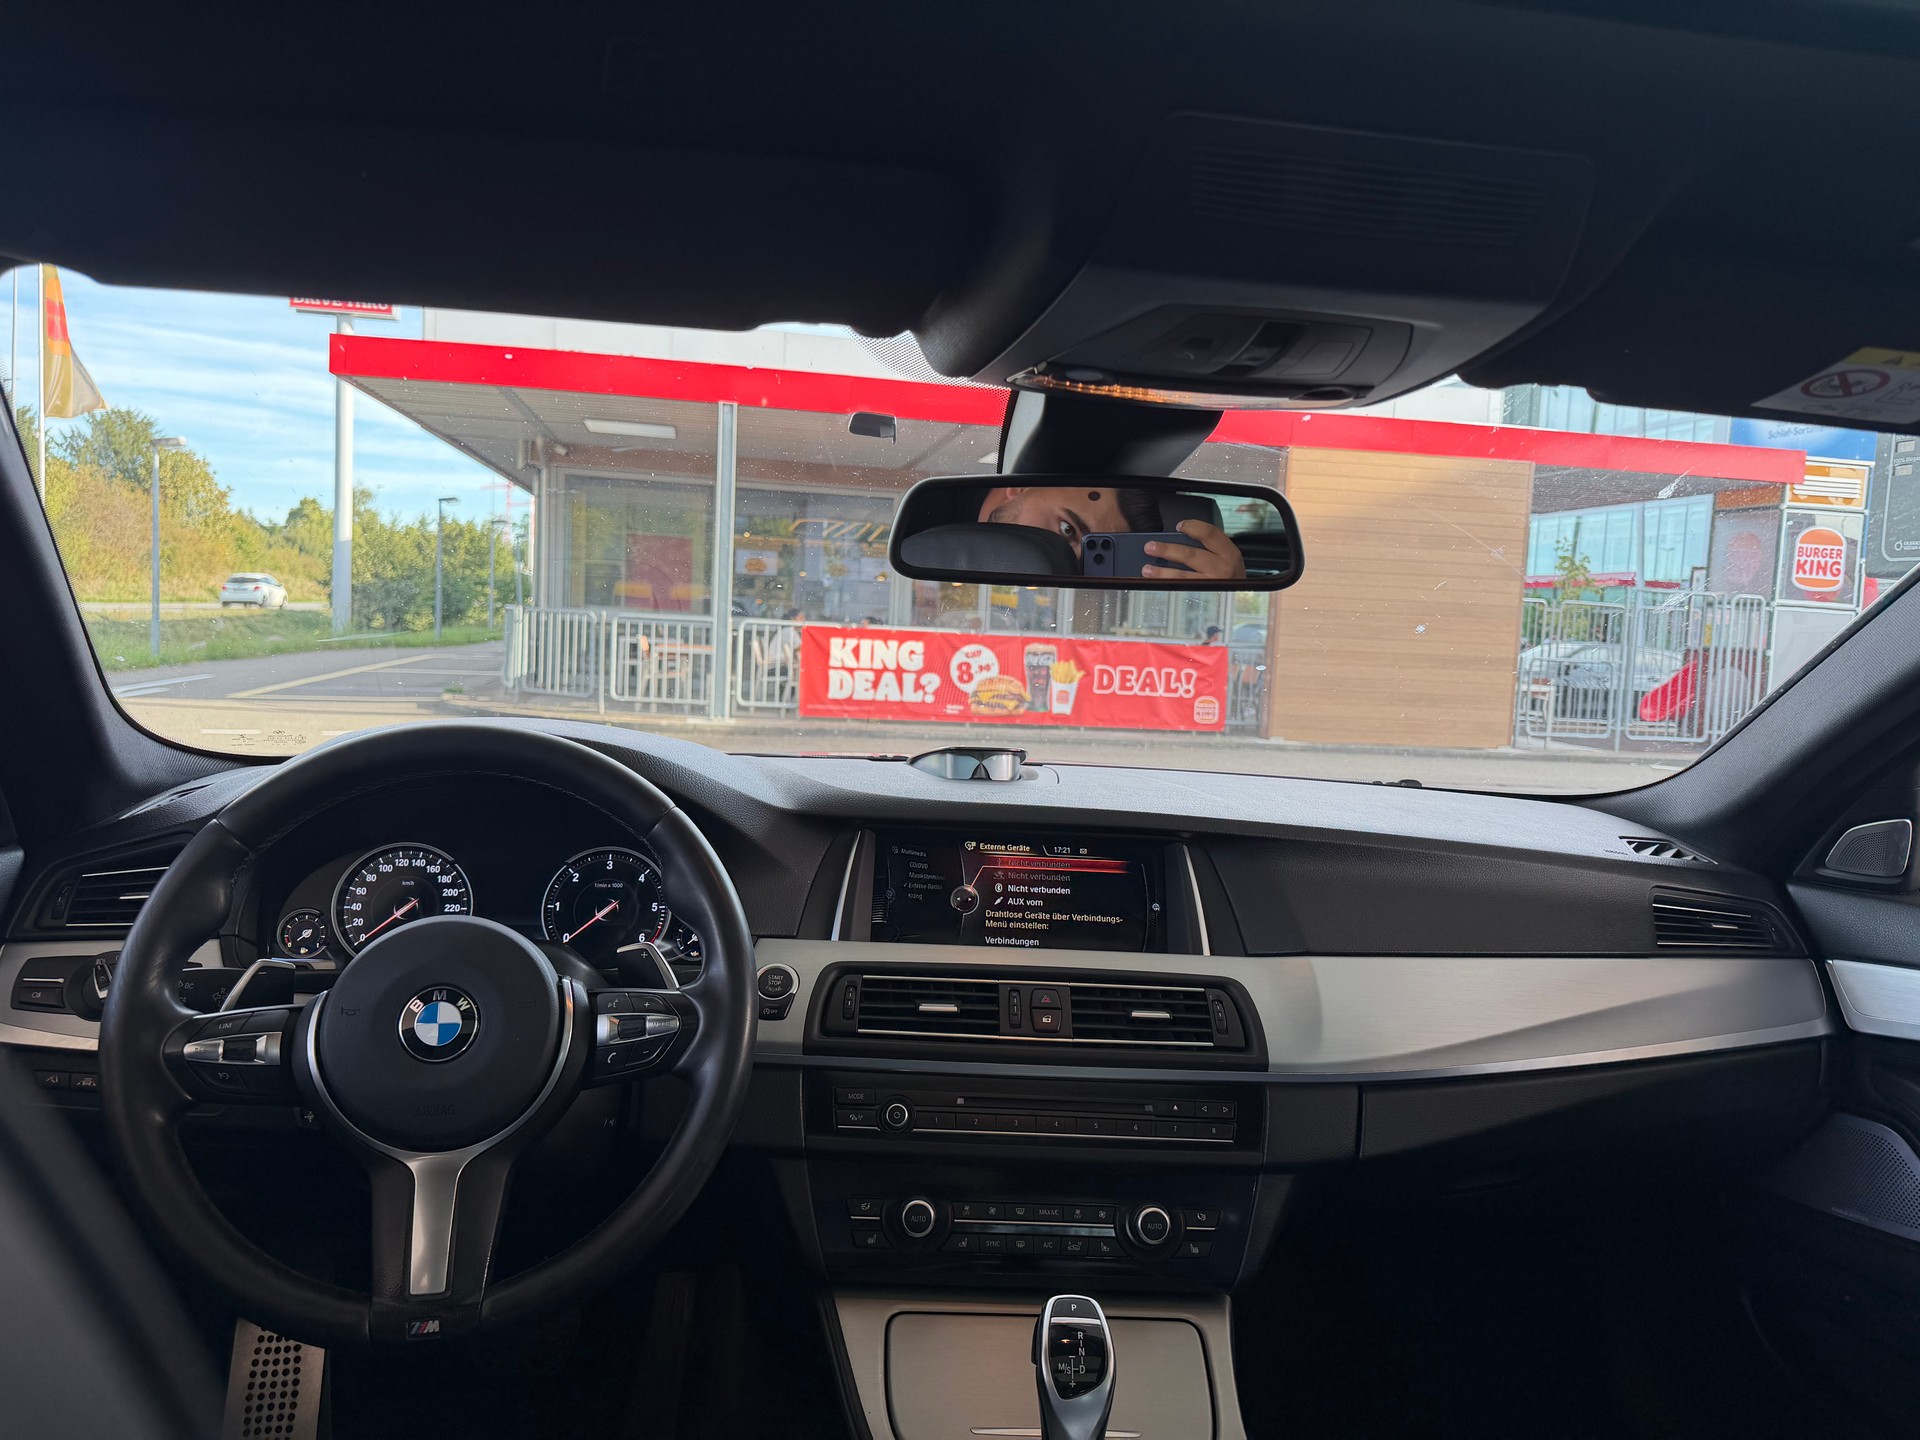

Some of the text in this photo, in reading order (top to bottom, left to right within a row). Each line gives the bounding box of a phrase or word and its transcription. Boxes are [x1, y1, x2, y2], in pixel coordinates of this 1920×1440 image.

[1797, 546, 1842, 560] BURGER
[1795, 558, 1842, 578] KING
[828, 637, 924, 671] KING
[1092, 664, 1198, 698] DEAL!
[827, 669, 941, 704] DEAL?
[980, 842, 1030, 852] Externe Geräte
[394, 859, 409, 867] 120
[412, 859, 426, 867] 140
[606, 861, 613, 870] 3
[1030, 860, 1070, 868] verbunden
[378, 864, 393, 872] 100
[426, 865, 441, 873] 160
[366, 874, 377, 882] 80
[437, 875, 452, 883] 180
[572, 874, 579, 882] 2
[638, 874, 645, 883] 4
[1030, 873, 1070, 882] verbunden
[356, 887, 367, 895] 60
[1008, 884, 1070, 894] Nicht verbunden
[555, 902, 560, 911] 1
[1007, 898, 1024, 906] AUX
[651, 902, 658, 912] 5
[985, 910, 1123, 924] Drahtlose Geräte über Verbindungs-
[353, 918, 364, 926] 20
[985, 920, 1049, 930] Menü einstellen:
[360, 934, 366, 942] 0
[563, 933, 569, 942] 0
[638, 933, 645, 943] 6
[985, 936, 1040, 947] Verbindungen
[409, 989, 472, 1013] BMW
[1077, 1331, 1084, 1340] R
[1078, 1347, 1085, 1356] N
[1058, 1363, 1086, 1375] M/S D
